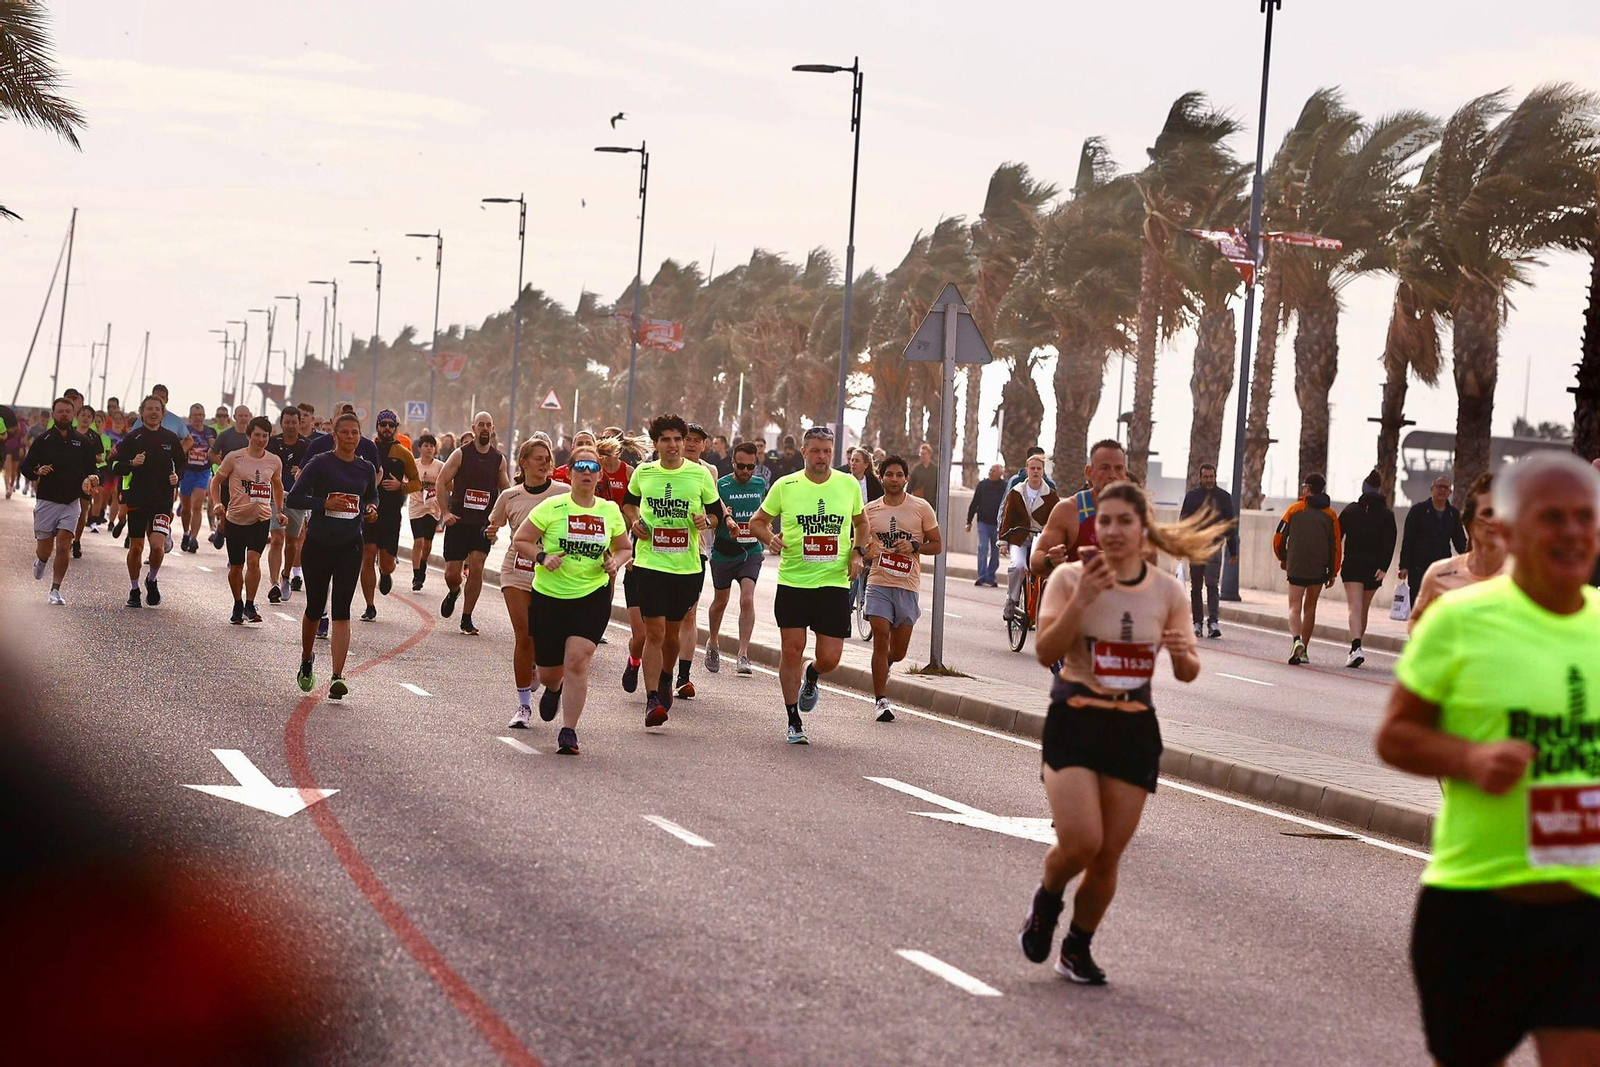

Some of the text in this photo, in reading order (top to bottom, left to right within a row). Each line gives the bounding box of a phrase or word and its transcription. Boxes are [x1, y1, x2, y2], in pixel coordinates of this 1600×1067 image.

[646, 496, 689, 510] BRUNCH
[652, 506, 671, 519] RUN
[735, 510, 754, 518] MÁLA
[795, 514, 844, 525] BRUNCH
[588, 523, 602, 532] 412
[802, 523, 825, 536] RUN
[671, 536, 686, 544] 650
[876, 530, 913, 541] BRUNCH
[558, 538, 606, 553] BRUNCH
[824, 544, 834, 552] 73
[1508, 708, 1600, 750] BRUN
